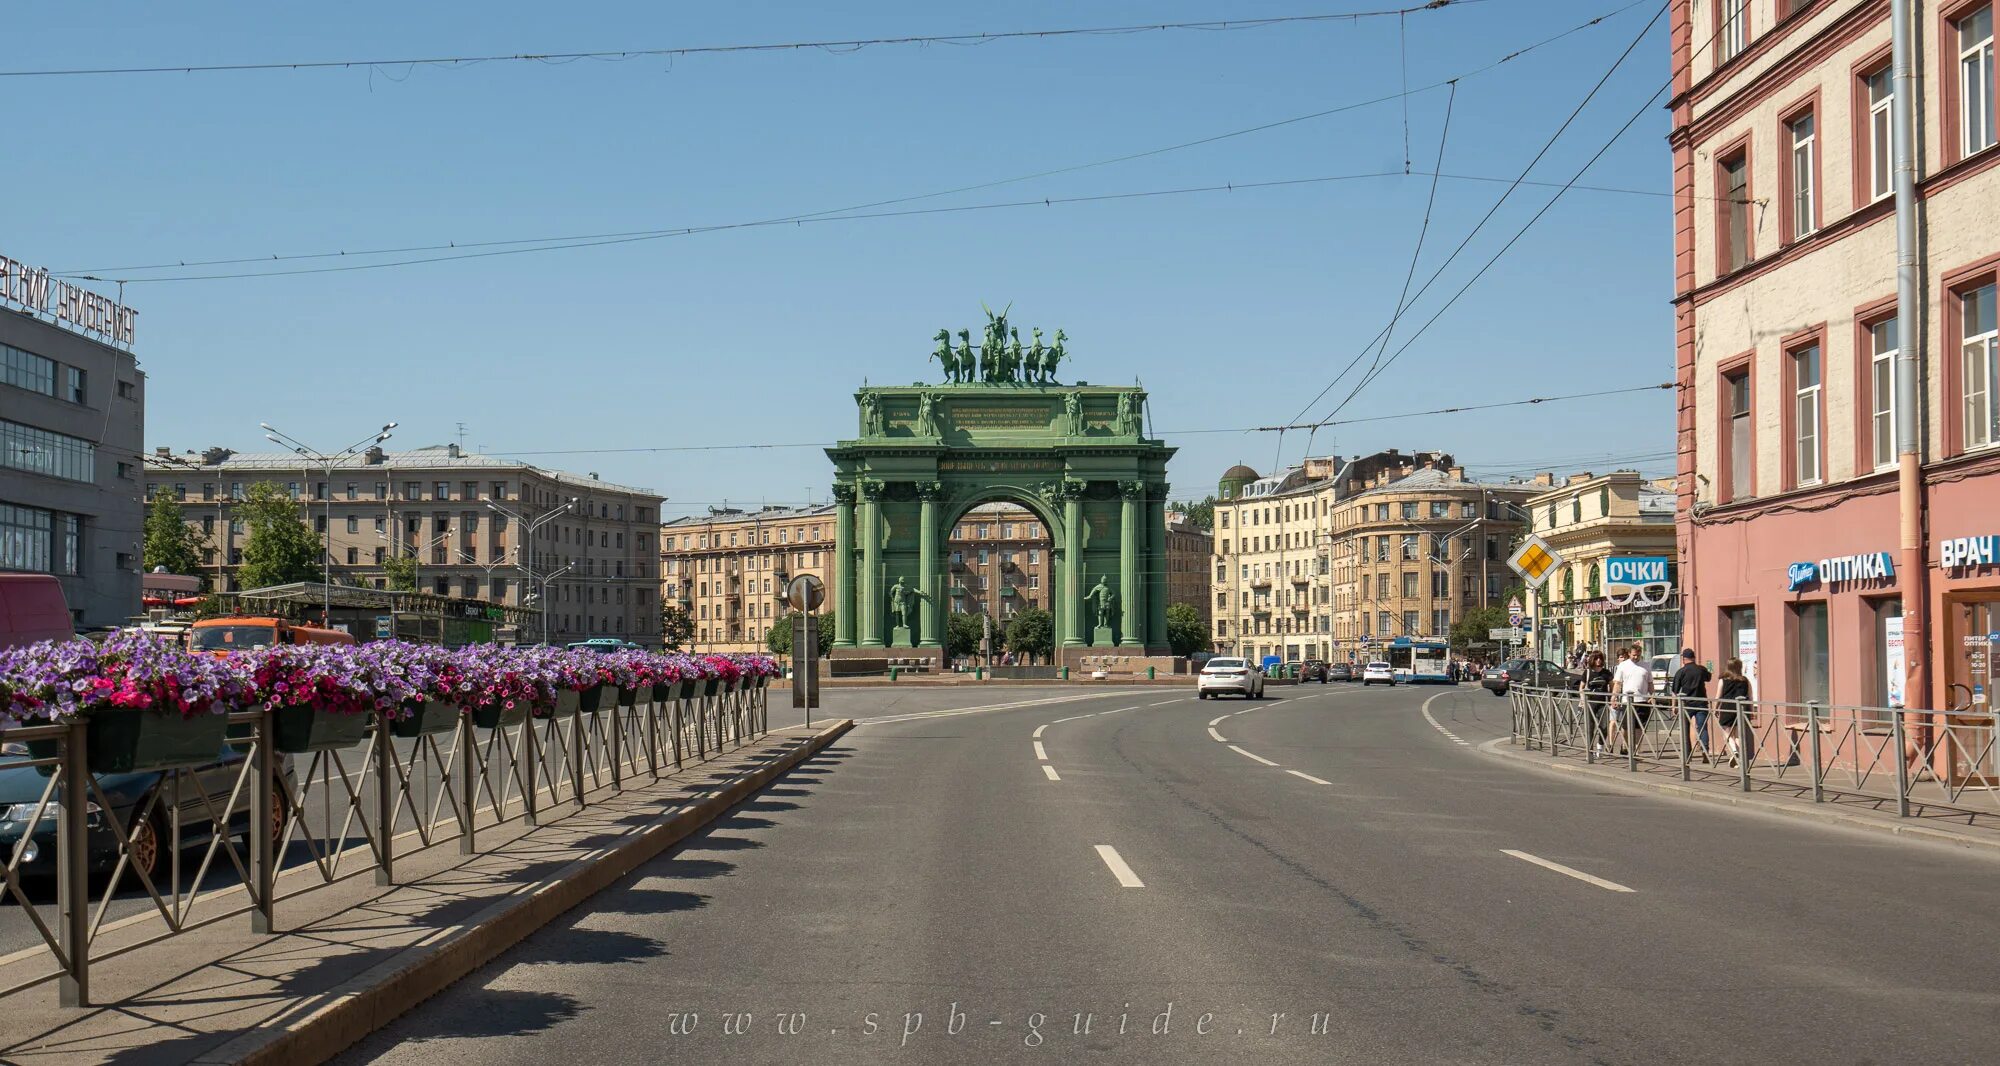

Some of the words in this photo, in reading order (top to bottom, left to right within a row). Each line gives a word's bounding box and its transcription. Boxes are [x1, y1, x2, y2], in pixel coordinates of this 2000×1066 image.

[58, 279, 139, 345] УНИВЕРМАГ
[1819, 552, 1887, 583] ОПТИКА
[1941, 535, 1993, 568] ВРАЧ
[1609, 561, 1665, 581] ОЧКИ
